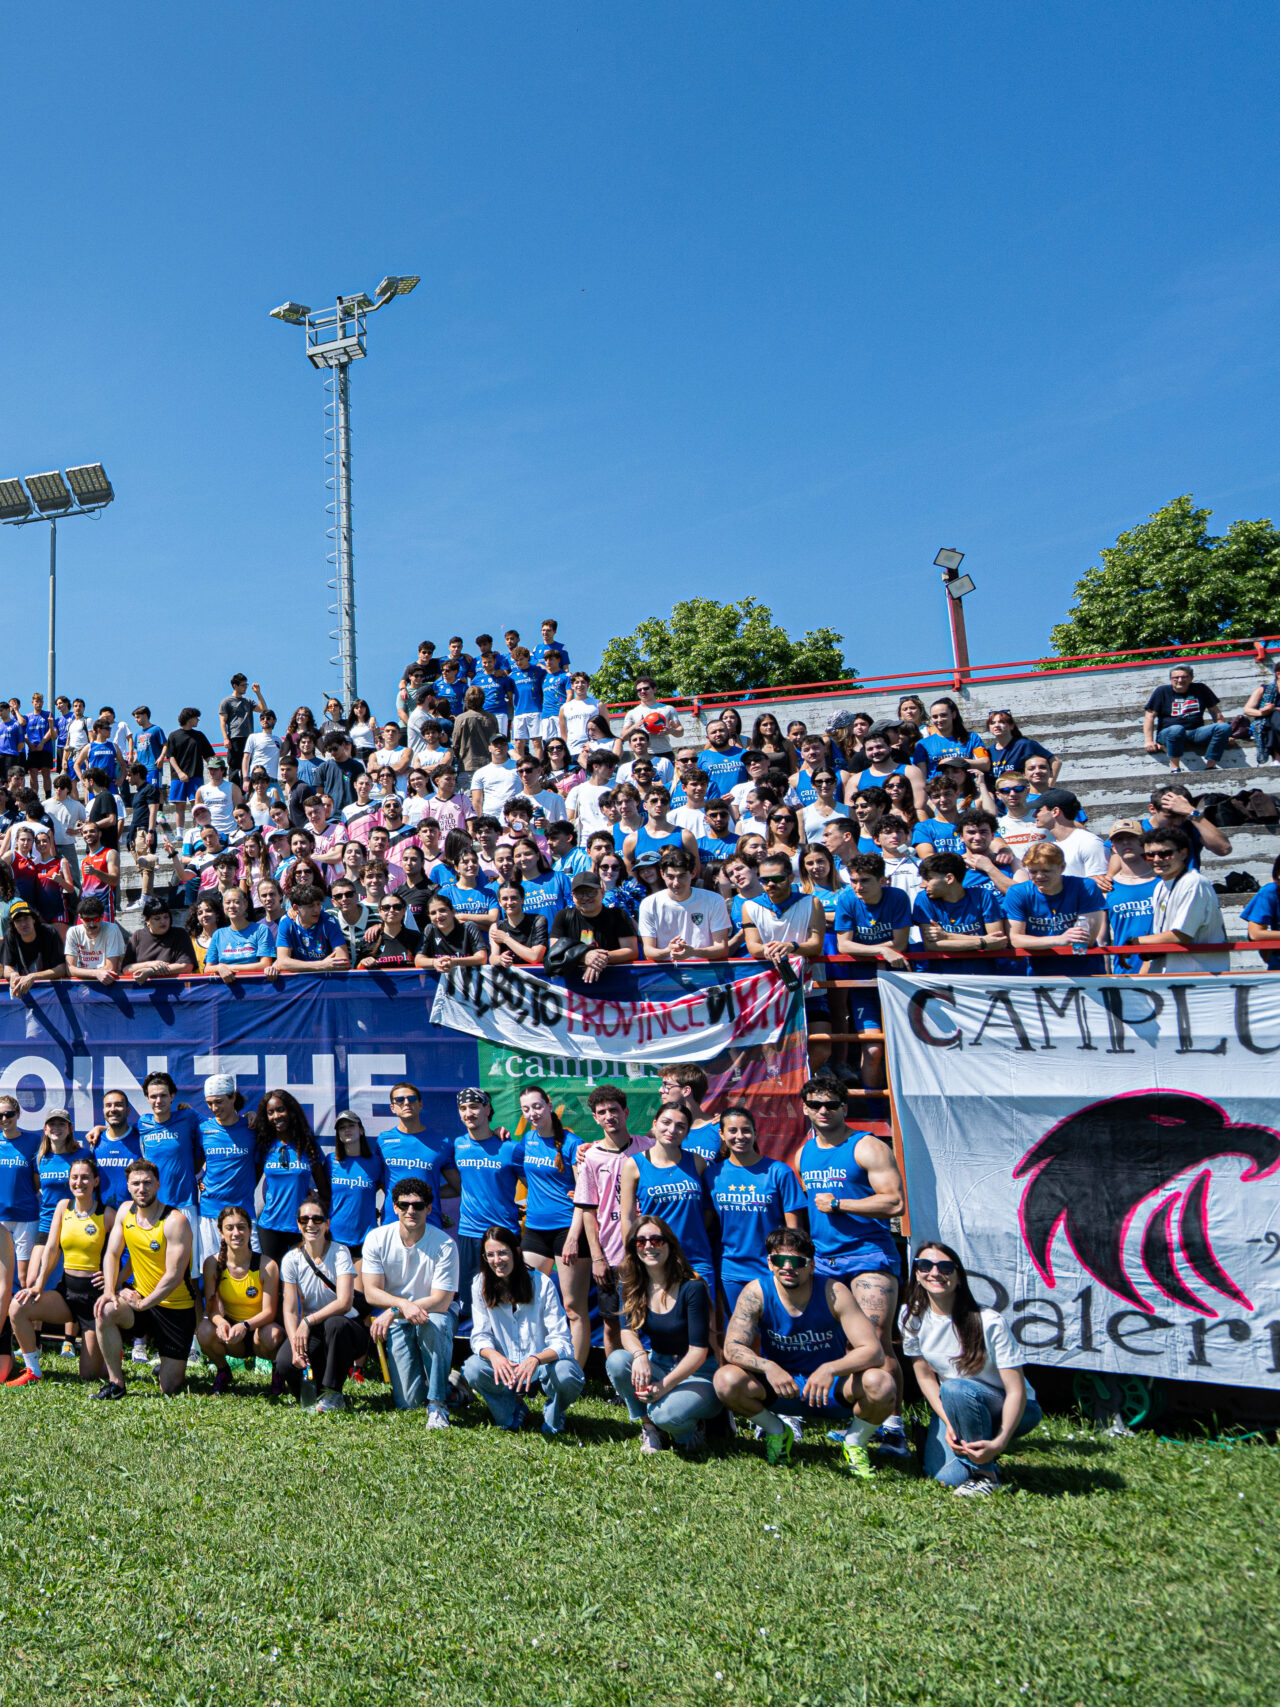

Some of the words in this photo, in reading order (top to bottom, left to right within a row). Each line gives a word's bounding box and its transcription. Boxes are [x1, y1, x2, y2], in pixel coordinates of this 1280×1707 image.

[934, 837, 963, 849] camp
[523, 890, 558, 905] amplus
[523, 901, 557, 912] IETRALATA
[1119, 908, 1155, 919] PIETRAL
[566, 989, 707, 1045] PROVINCE
[856, 1007, 865, 1020] 7
[194, 1054, 407, 1136] THE
[143, 1128, 179, 1143] camplus
[206, 1143, 249, 1157] camplus
[385, 1156, 433, 1171] camplus
[456, 1156, 502, 1170] camplus
[523, 1154, 557, 1168] amplu
[40, 1168, 70, 1181] campl
[801, 1166, 848, 1183] camplus
[331, 1175, 375, 1190] camplus
[647, 1179, 702, 1198] camplus
[716, 1185, 773, 1206] camplus
[718, 1204, 769, 1214] PIETRALATA
[767, 1328, 834, 1344] camplus
